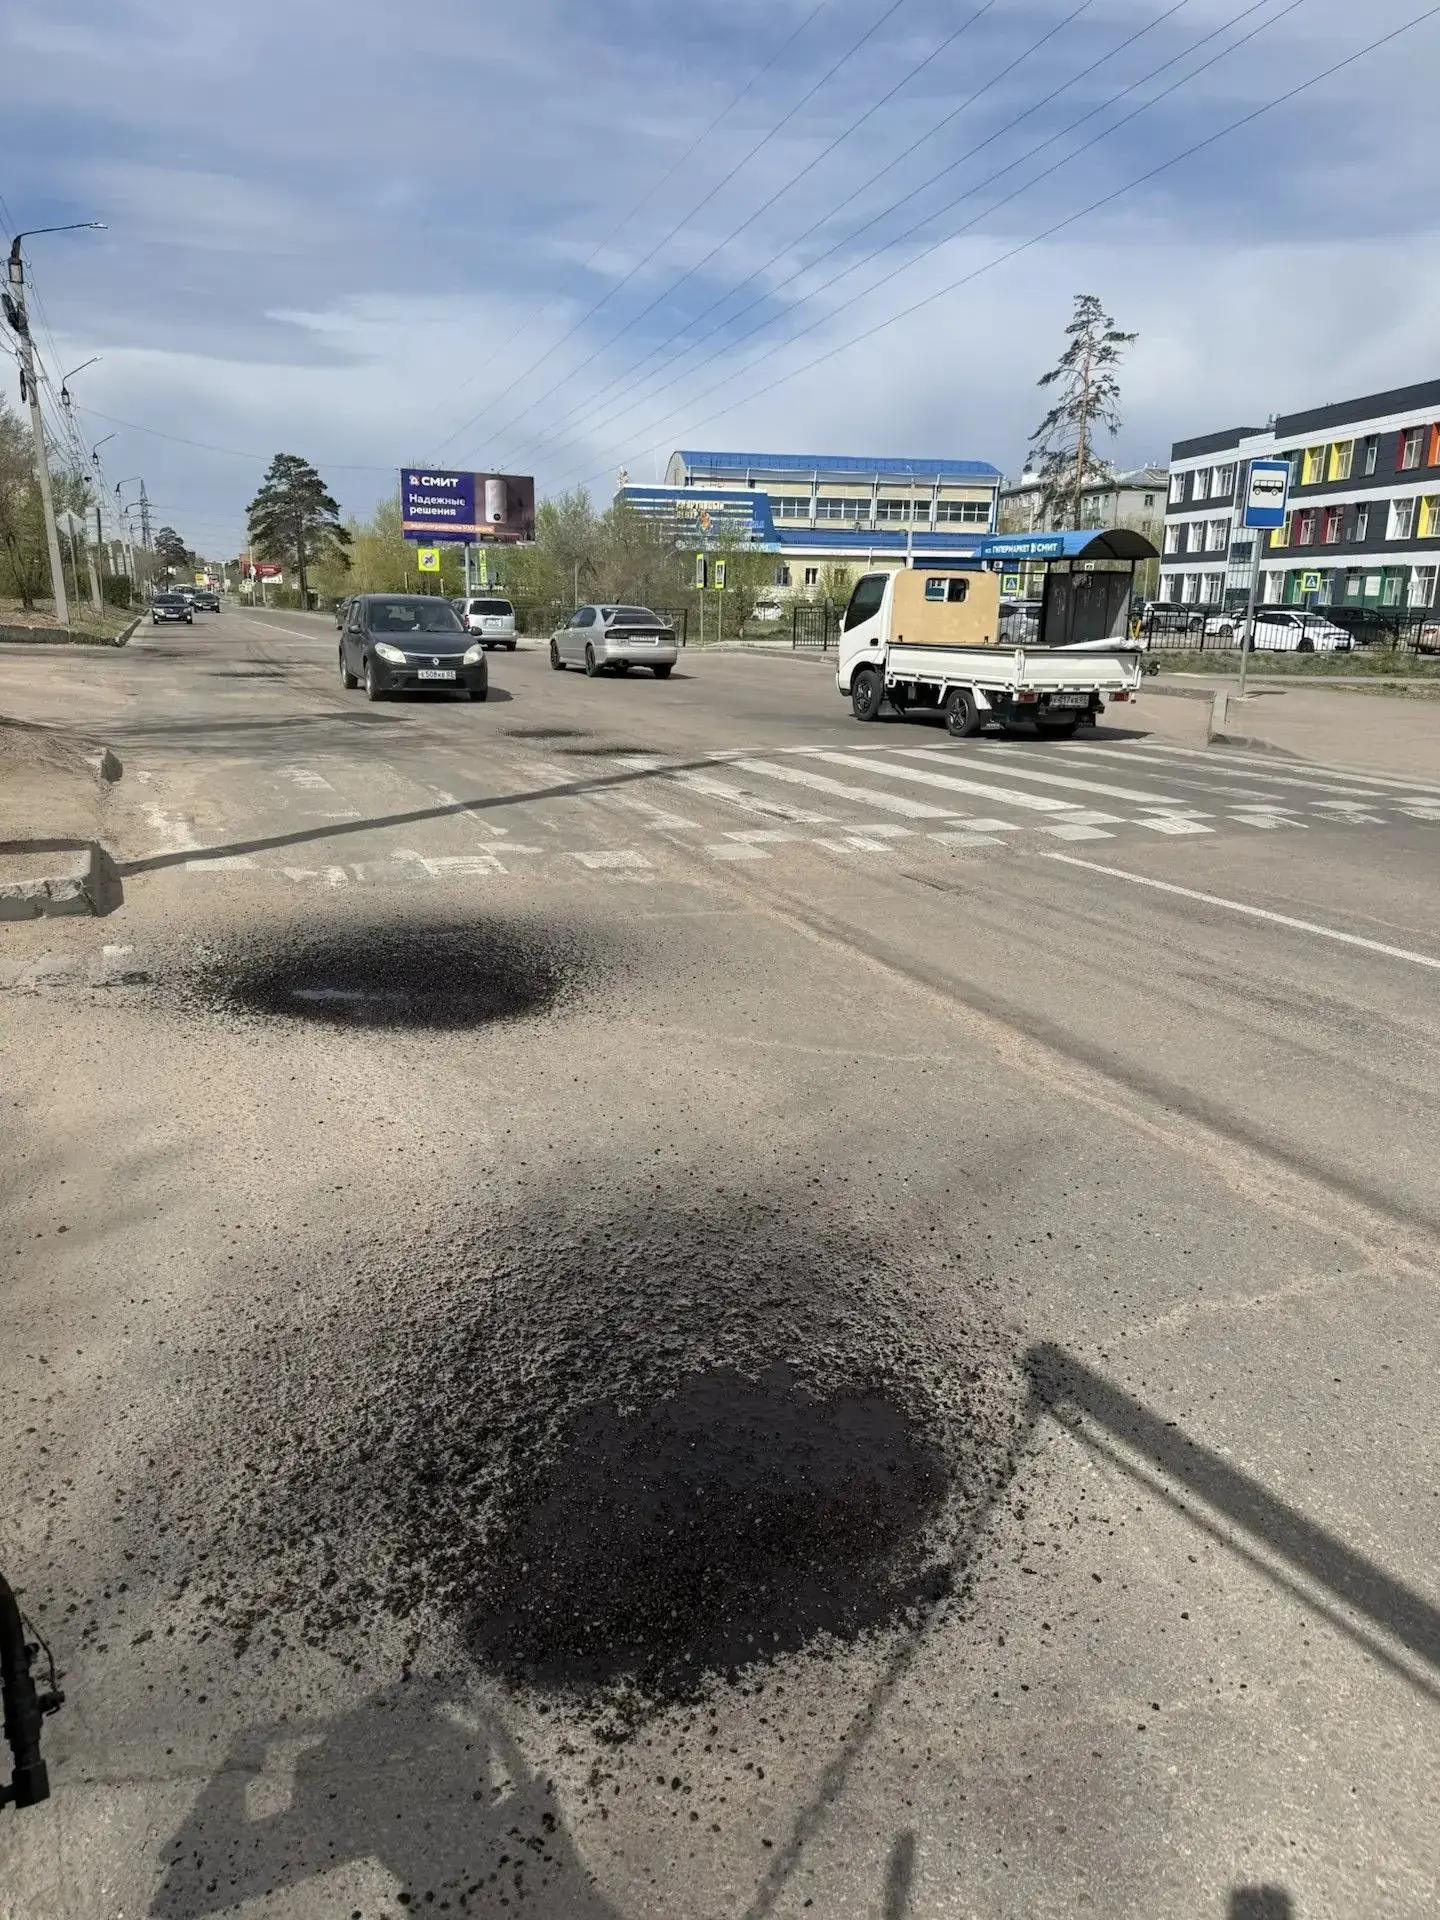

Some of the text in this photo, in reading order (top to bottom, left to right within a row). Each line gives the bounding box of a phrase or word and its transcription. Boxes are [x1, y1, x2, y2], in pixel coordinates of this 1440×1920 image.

[421, 476, 459, 488] СМИТ
[409, 493, 466, 507] Надежные
[409, 506, 457, 516] решения
[992, 544, 1030, 554] ГИПЕРМАРКЕТ
[1036, 542, 1058, 552] СМИТ
